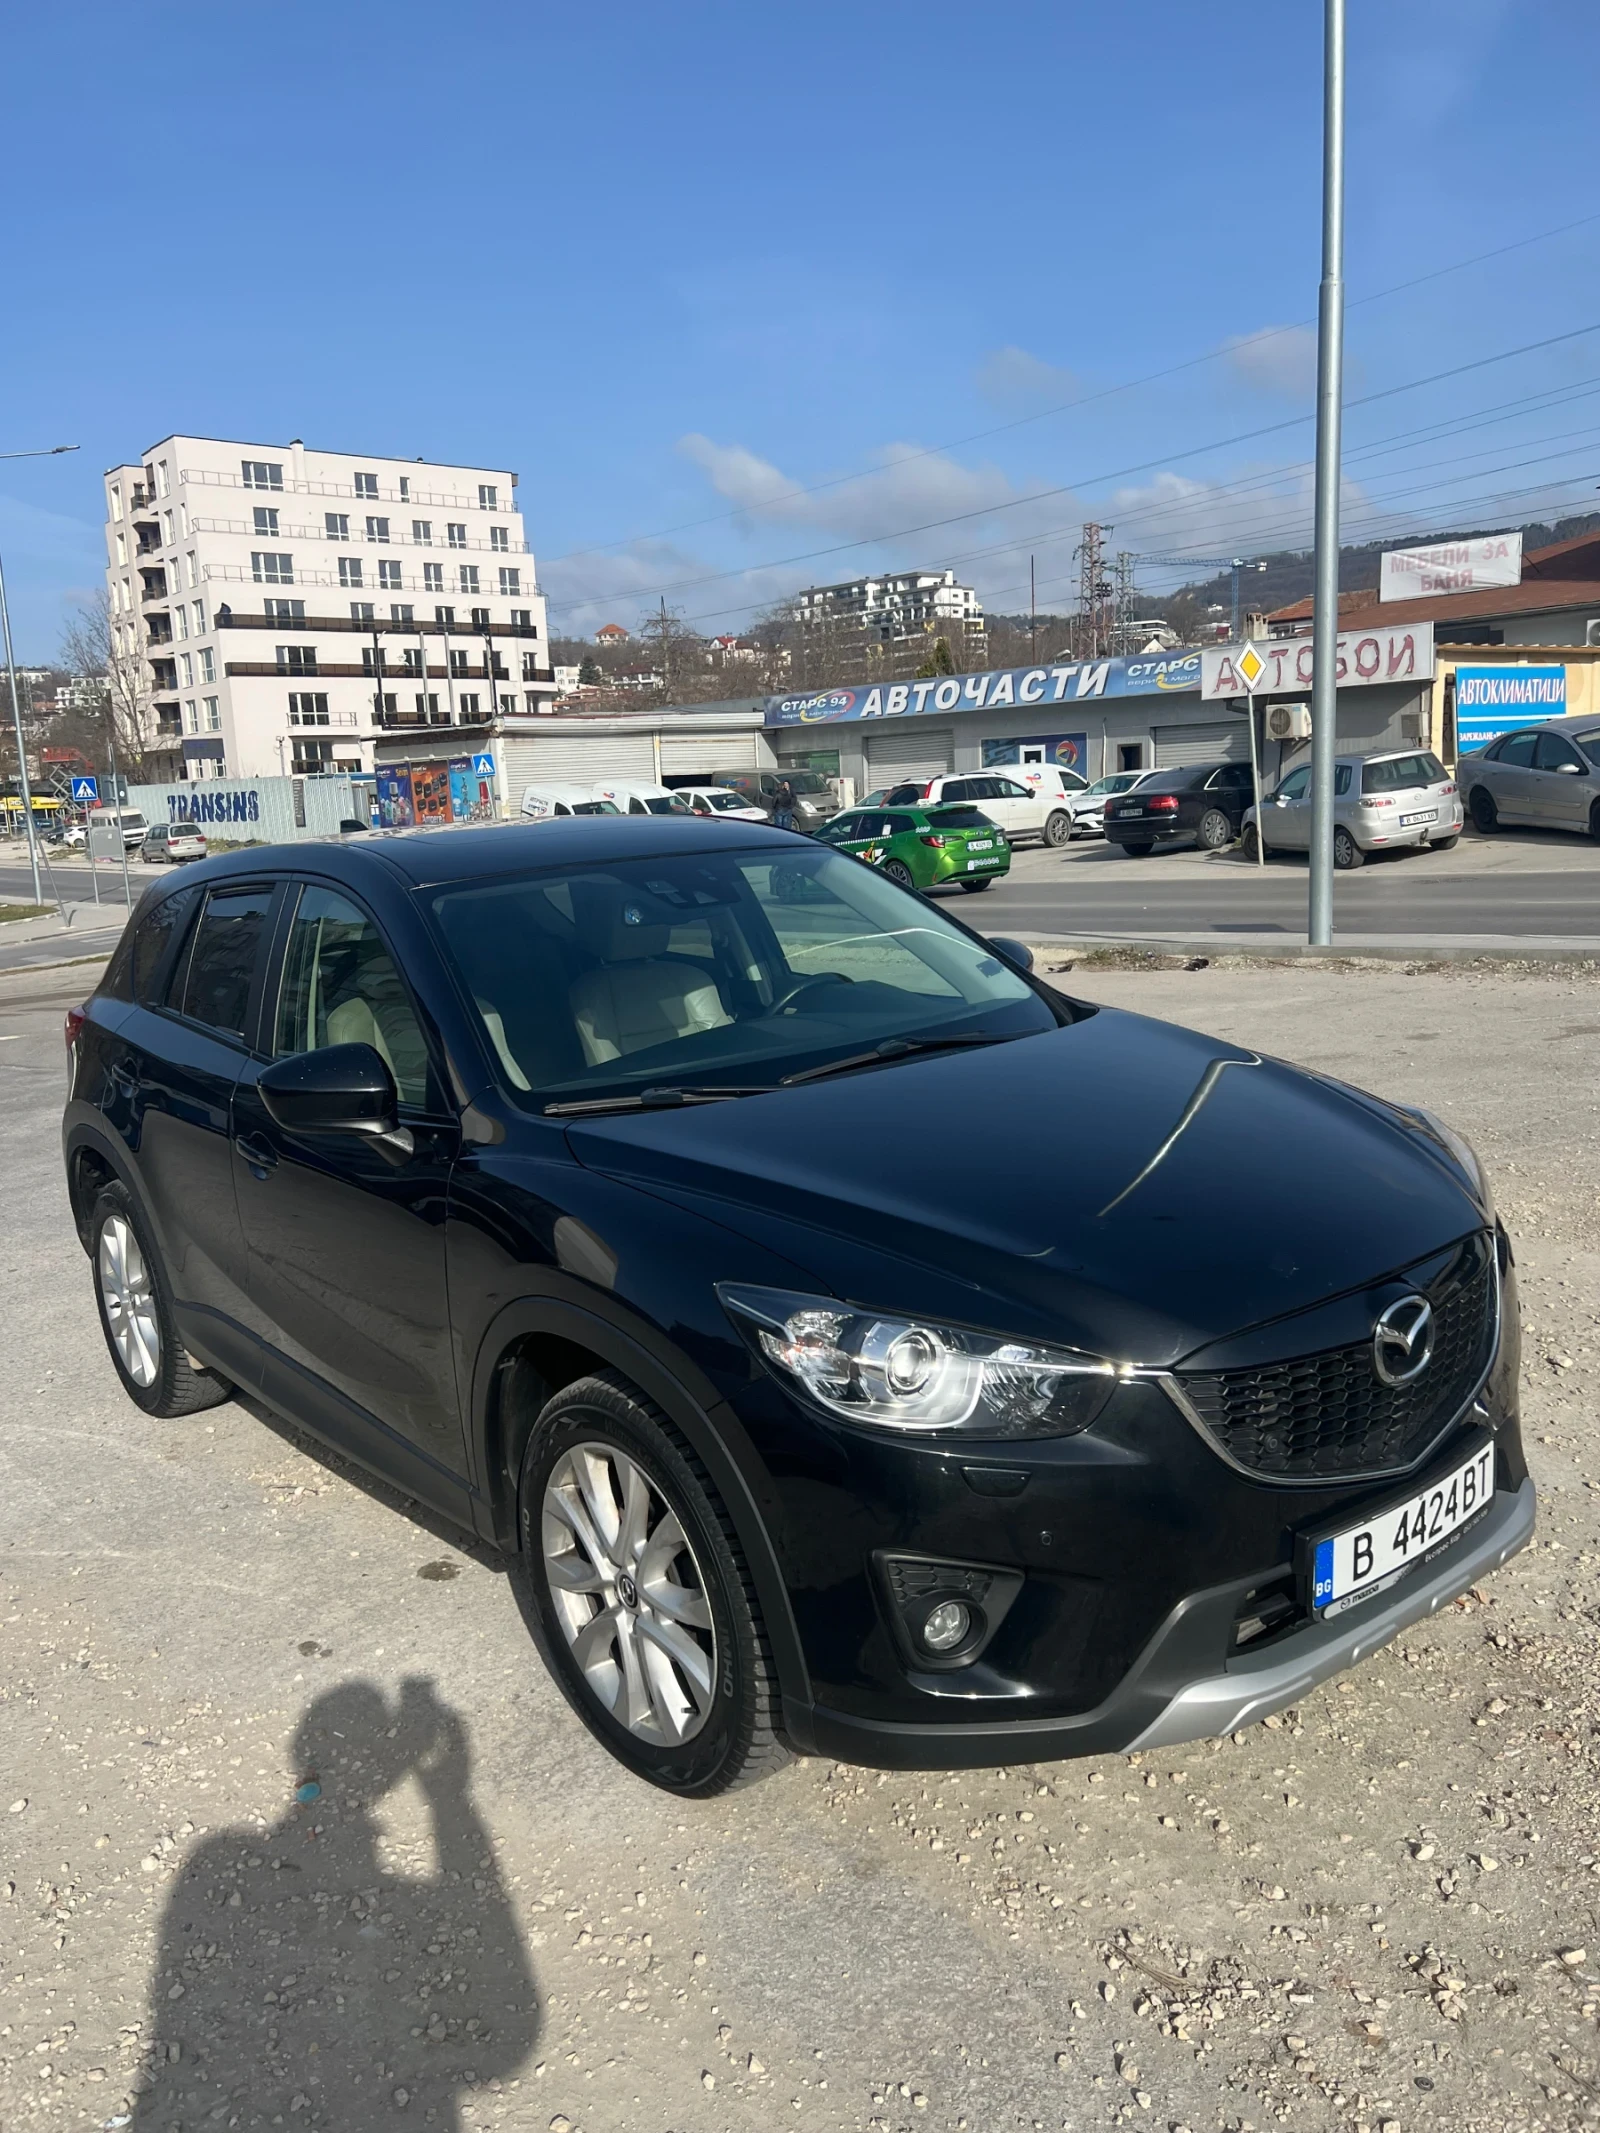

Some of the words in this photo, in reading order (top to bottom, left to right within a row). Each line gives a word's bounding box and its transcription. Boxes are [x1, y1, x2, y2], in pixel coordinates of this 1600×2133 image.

[1391, 546, 1470, 573] МЕБЕЛИ
[1482, 541, 1509, 560] ЗА
[1420, 568, 1473, 592] БАНЯ
[1127, 658, 1199, 677] СТАРС
[1213, 634, 1415, 692] АТОБОИ
[781, 698, 827, 711] СТАРС
[830, 696, 847, 707] 94
[860, 663, 1111, 717] АВТОЧАСТИ
[1458, 678, 1565, 705] АВТОКЛИМАТИЦИ
[167, 790, 260, 823] TRANSINS
[1353, 1531, 1374, 1582] B
[1316, 1578, 1332, 1598] BG
